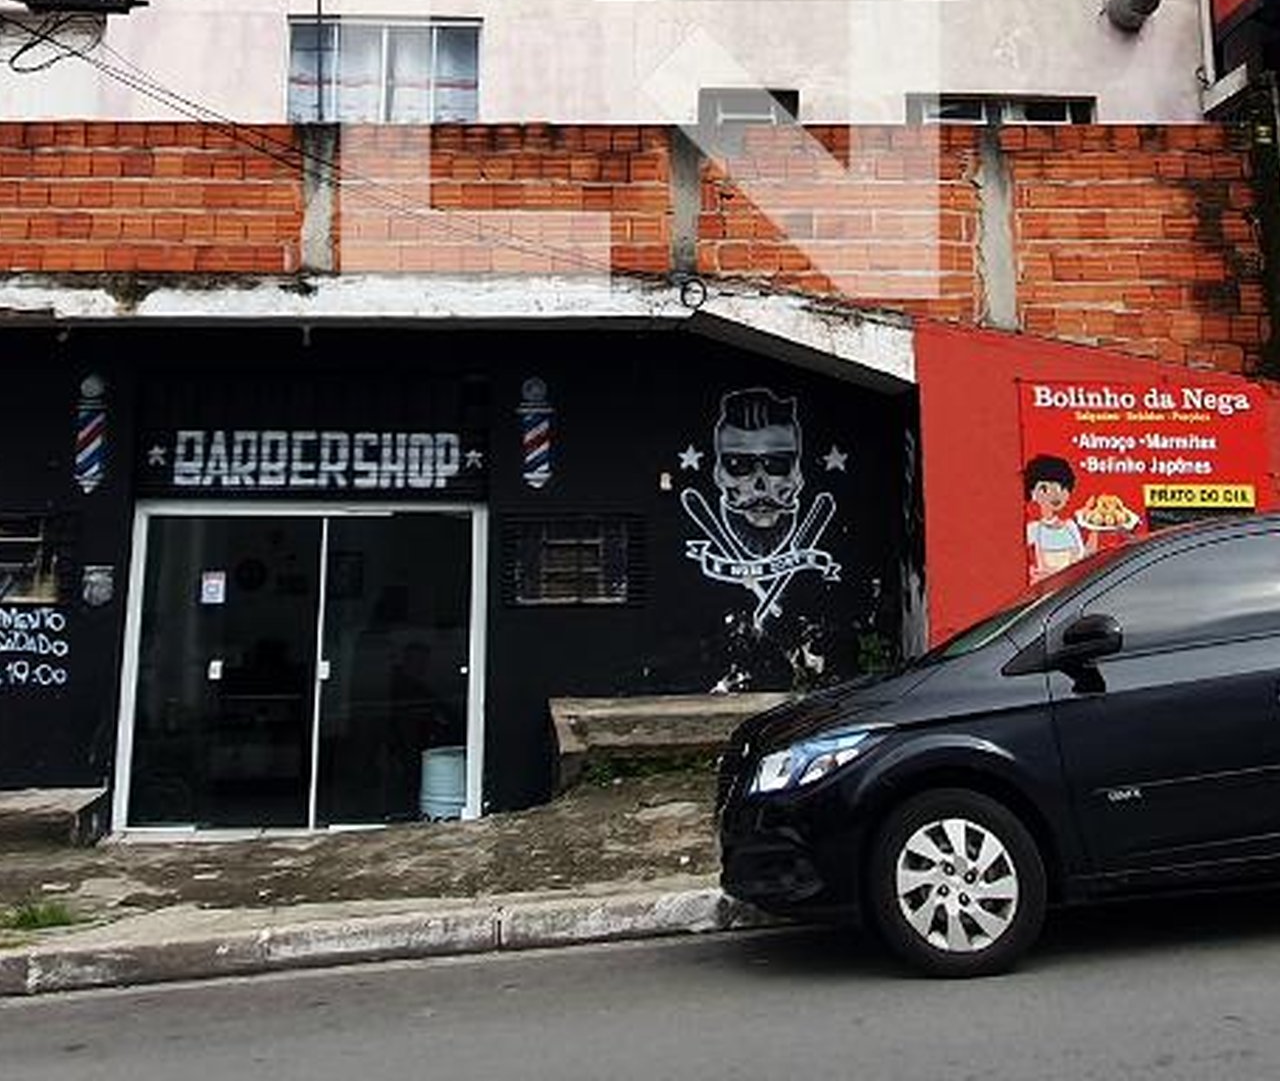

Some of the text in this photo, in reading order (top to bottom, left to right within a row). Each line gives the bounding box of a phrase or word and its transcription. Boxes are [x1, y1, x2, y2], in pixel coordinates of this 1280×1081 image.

[1034, 386, 1250, 415] Bolinho da Nega
[1086, 456, 1146, 473] Bolinho
